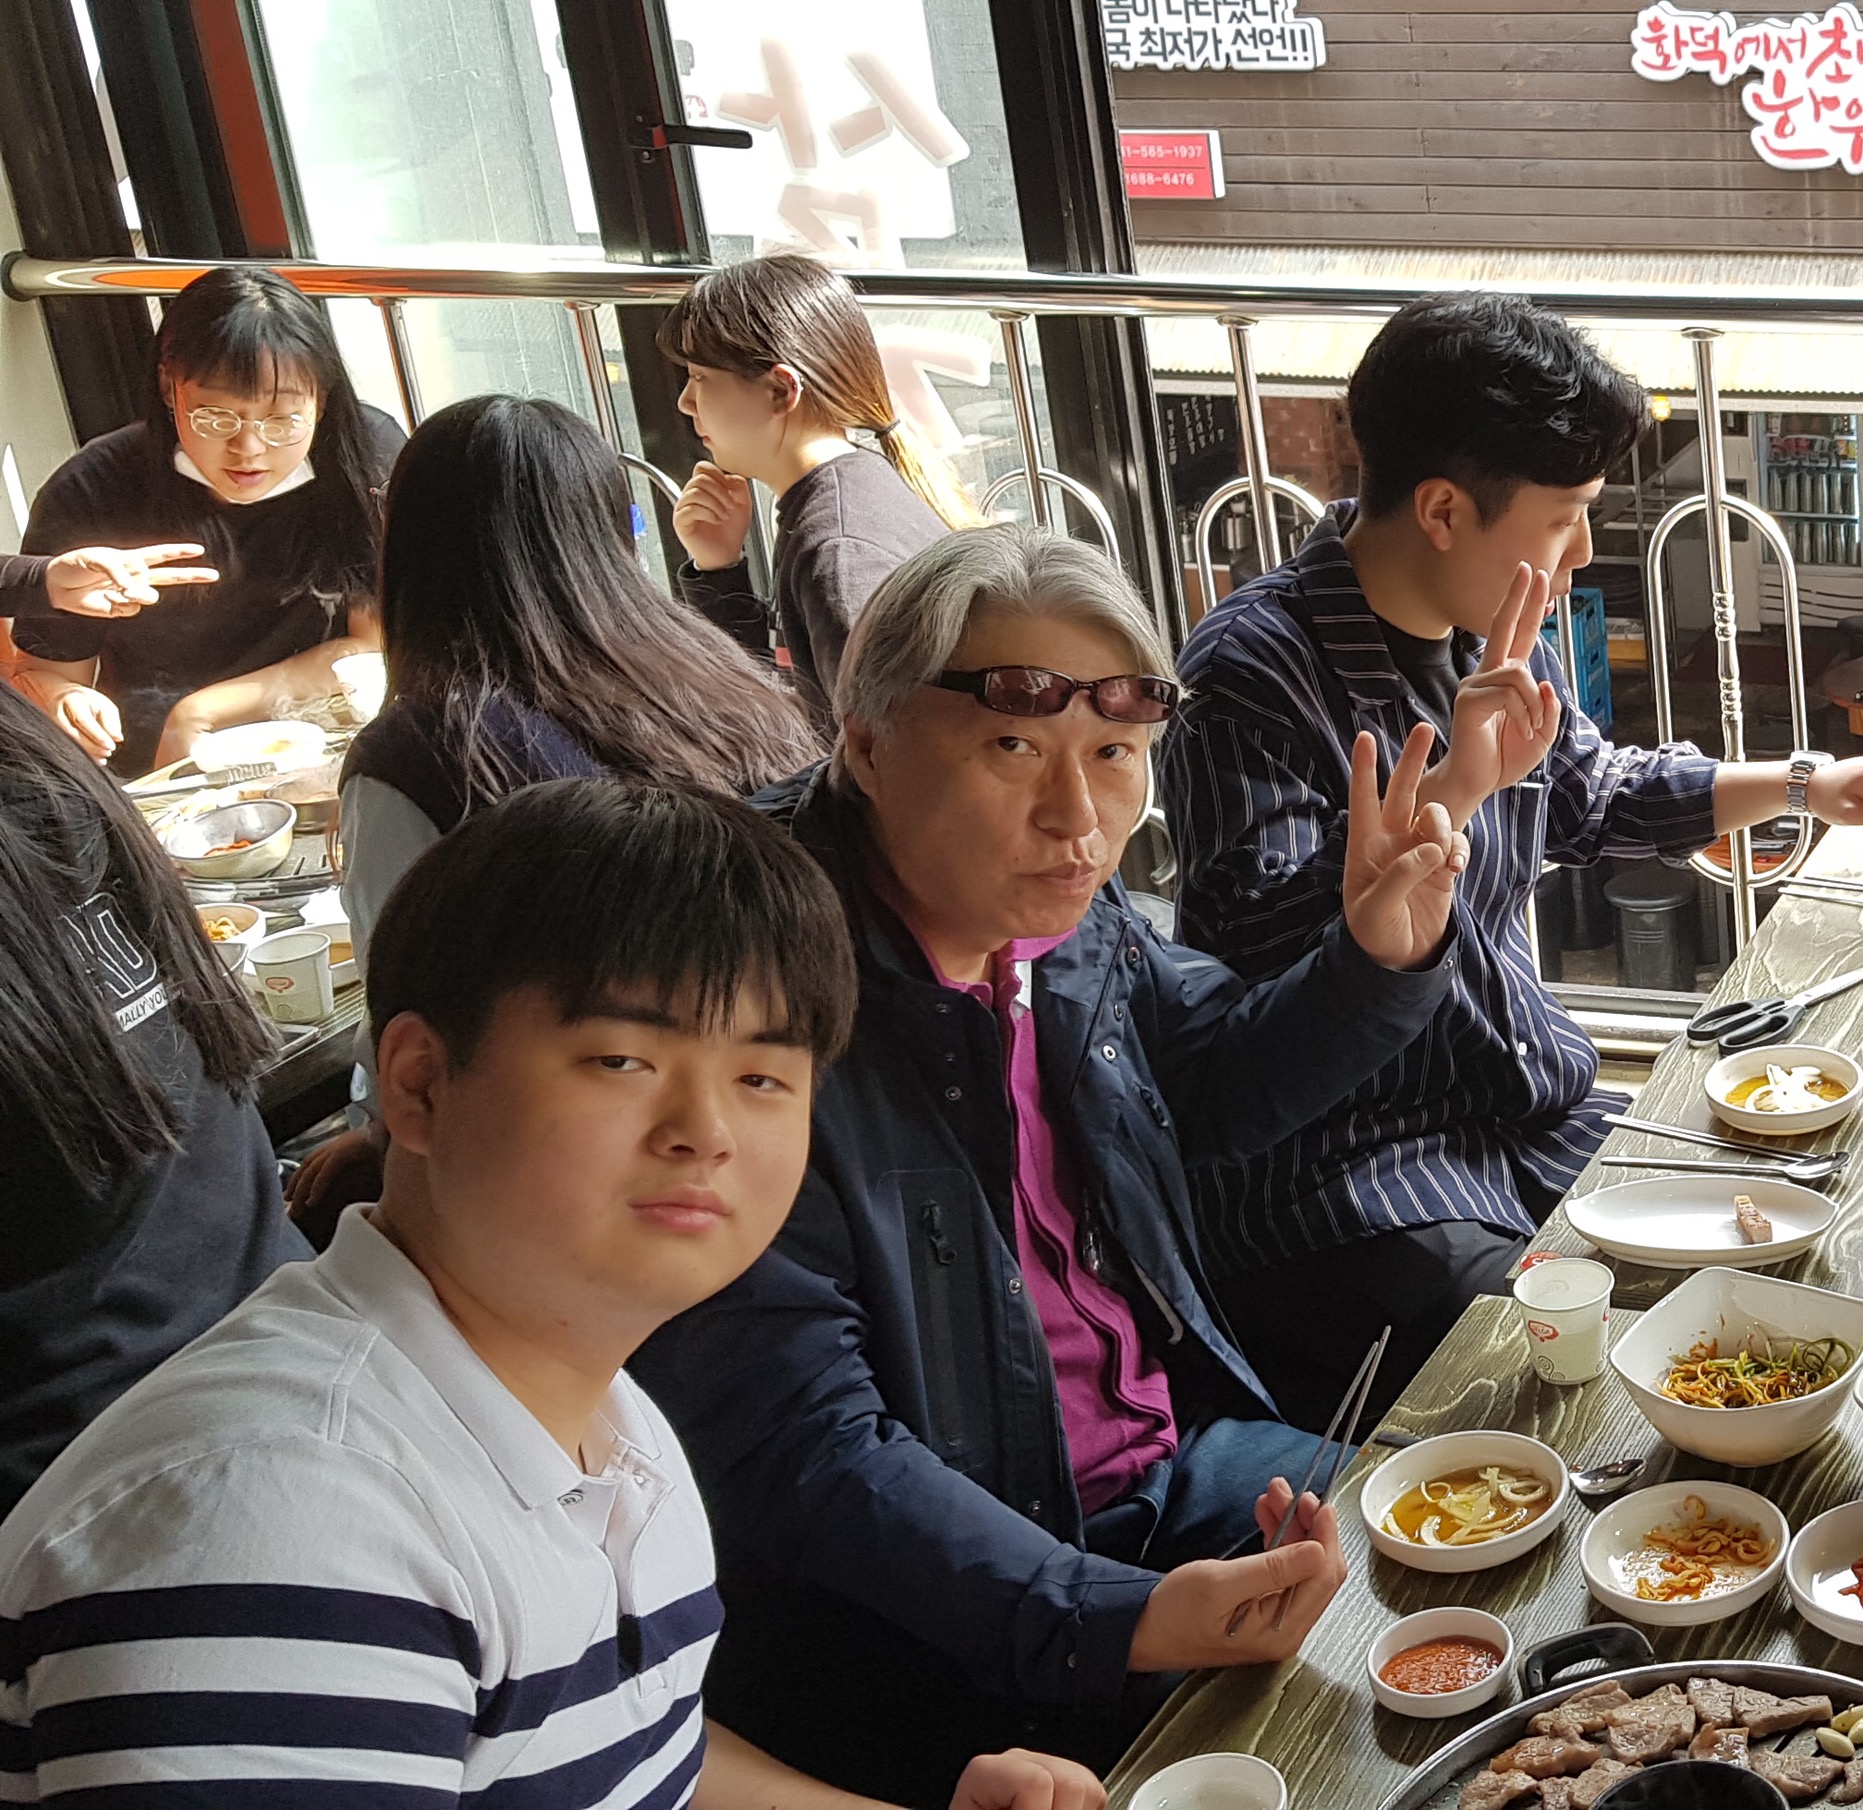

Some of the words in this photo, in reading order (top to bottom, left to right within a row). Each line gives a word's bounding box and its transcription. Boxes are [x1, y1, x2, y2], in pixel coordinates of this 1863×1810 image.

[1139, 27, 1222, 62] 최저가
[1230, 27, 1309, 62] 선언!!
[1639, 15, 1807, 77] 화덕에서
